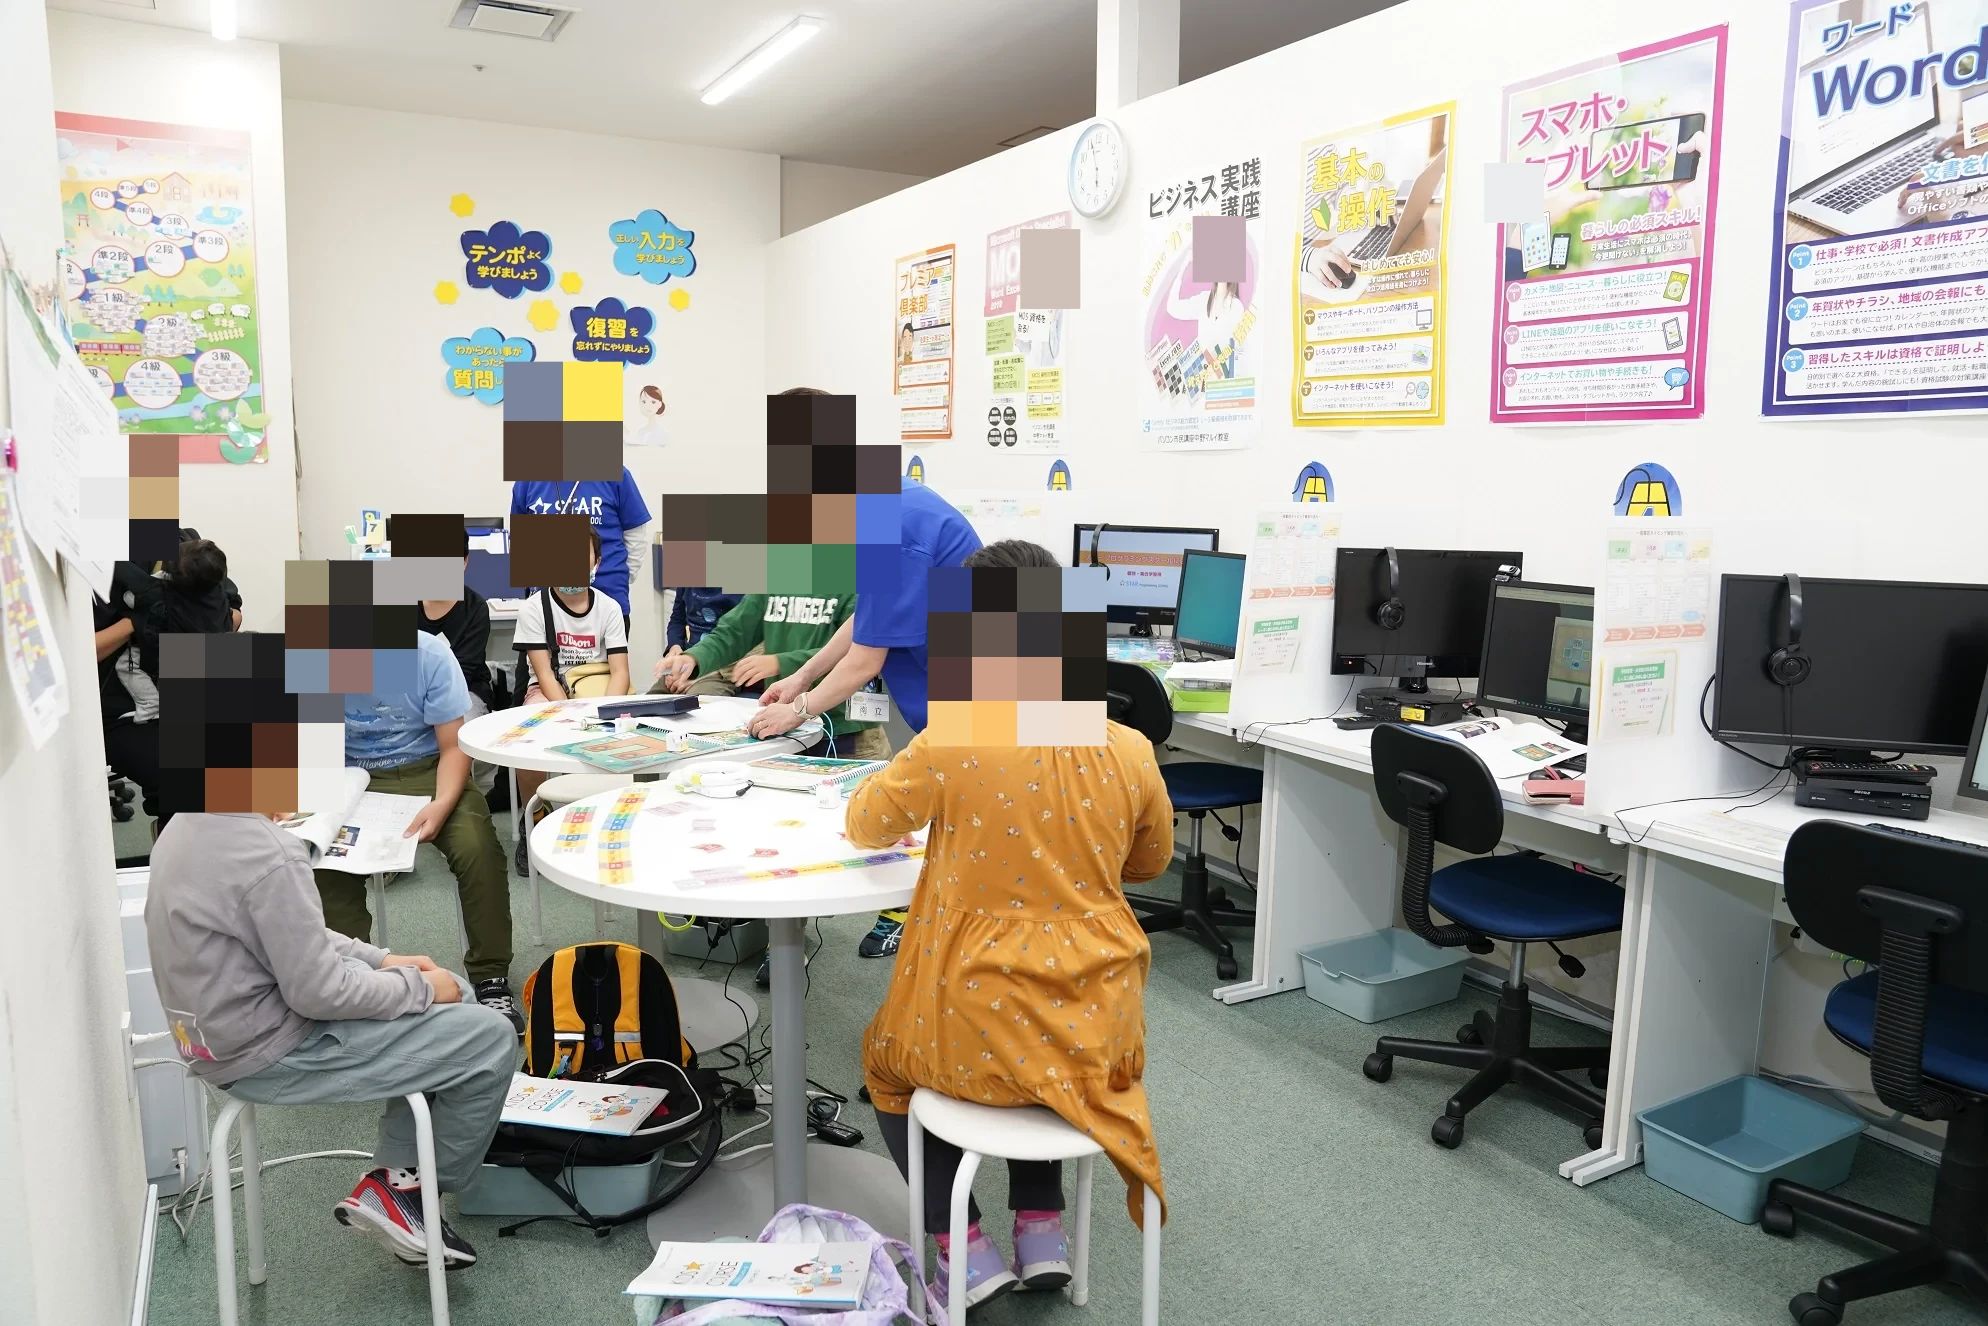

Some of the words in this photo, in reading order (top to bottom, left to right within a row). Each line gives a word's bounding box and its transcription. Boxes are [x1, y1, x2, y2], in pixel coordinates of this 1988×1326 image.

[1822, 2, 1913, 53] ワード
[1812, 27, 1988, 118] Word
[1525, 131, 1668, 188] ブレット
[1221, 157, 1261, 195] 実践
[1311, 148, 1385, 193] 基本の
[94, 190, 109, 199] 4段
[1150, 174, 1218, 219] ビジネス
[128, 206, 150, 215] 準4段
[1337, 187, 1398, 233] 操作
[166, 217, 182, 226] 3段
[198, 236, 224, 246] 準3段
[616, 231, 685, 251] 正しい入力を
[98, 250, 129, 262] 準2段
[154, 244, 174, 254] 2段
[468, 244, 541, 264] テンポよく
[635, 252, 685, 265] 学びましょう
[477, 265, 538, 280] 学びましょう
[103, 292, 123, 302] 1級
[900, 293, 928, 316] 倶楽部
[586, 316, 639, 338] 復習を
[1521, 318, 1658, 339] LINEや話題のアプリを使いこなそう!
[455, 344, 523, 357] わからない事が
[575, 341, 650, 354] 忘れずにやりましょう
[1315, 342, 1397, 356] いろんなアプリを使ってみよう!
[1808, 342, 1988, 365] 習得したスキルは資格で証明しよ
[211, 352, 231, 361] 3級
[140, 361, 161, 371] 4級
[1520, 365, 1653, 381] インターネットでお買い物や手続きも!
[453, 369, 503, 390] 質問し
[1313, 381, 1394, 392] インターネットを使いこなそう!
